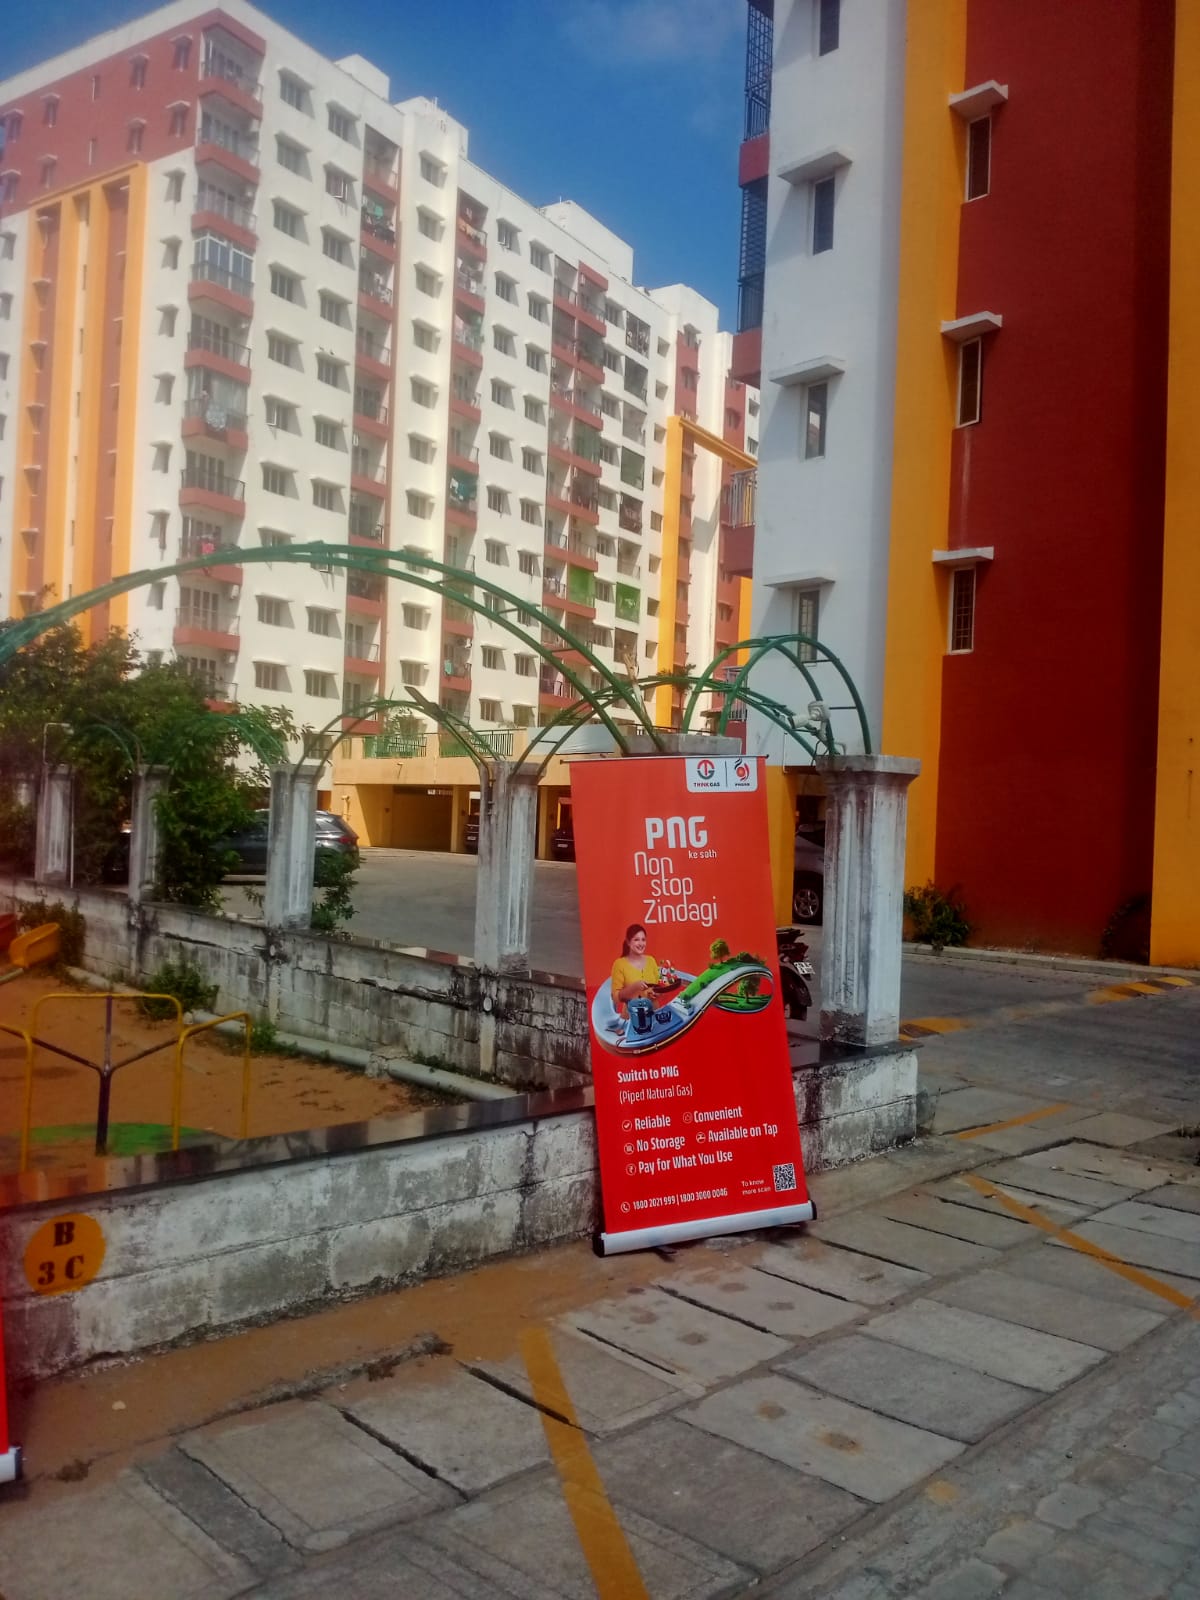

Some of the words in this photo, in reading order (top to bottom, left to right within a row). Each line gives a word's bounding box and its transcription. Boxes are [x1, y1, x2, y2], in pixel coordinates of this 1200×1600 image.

[645, 816, 708, 849] PNG
[634, 852, 673, 876] Non
[688, 850, 698, 859] ke
[700, 850, 717, 859] sath
[651, 876, 693, 899] stop
[643, 896, 718, 928] Zindagi
[617, 1069, 648, 1083] Switch
[649, 1068, 659, 1079] to
[661, 1065, 679, 1078] PNG
[619, 1088, 645, 1104] (Piped
[646, 1085, 675, 1100] Natural
[676, 1083, 693, 1097] Gas)
[634, 1114, 671, 1130] Reliable
[693, 1106, 743, 1123] Convenient
[636, 1139, 649, 1152] No
[651, 1134, 685, 1149] Storage
[708, 1126, 748, 1142] Available
[750, 1126, 762, 1136] on
[763, 1123, 778, 1136] Tap
[638, 1161, 655, 1175] Pay
[656, 1158, 671, 1171] for
[672, 1154, 697, 1168] What
[698, 1152, 715, 1164] You
[716, 1150, 733, 1162] Use
[633, 1200, 648, 1210] 1800
[664, 1196, 676, 1205] 999
[54, 1221, 75, 1247] B
[37, 1261, 56, 1286] 3
[64, 1254, 85, 1280] C
